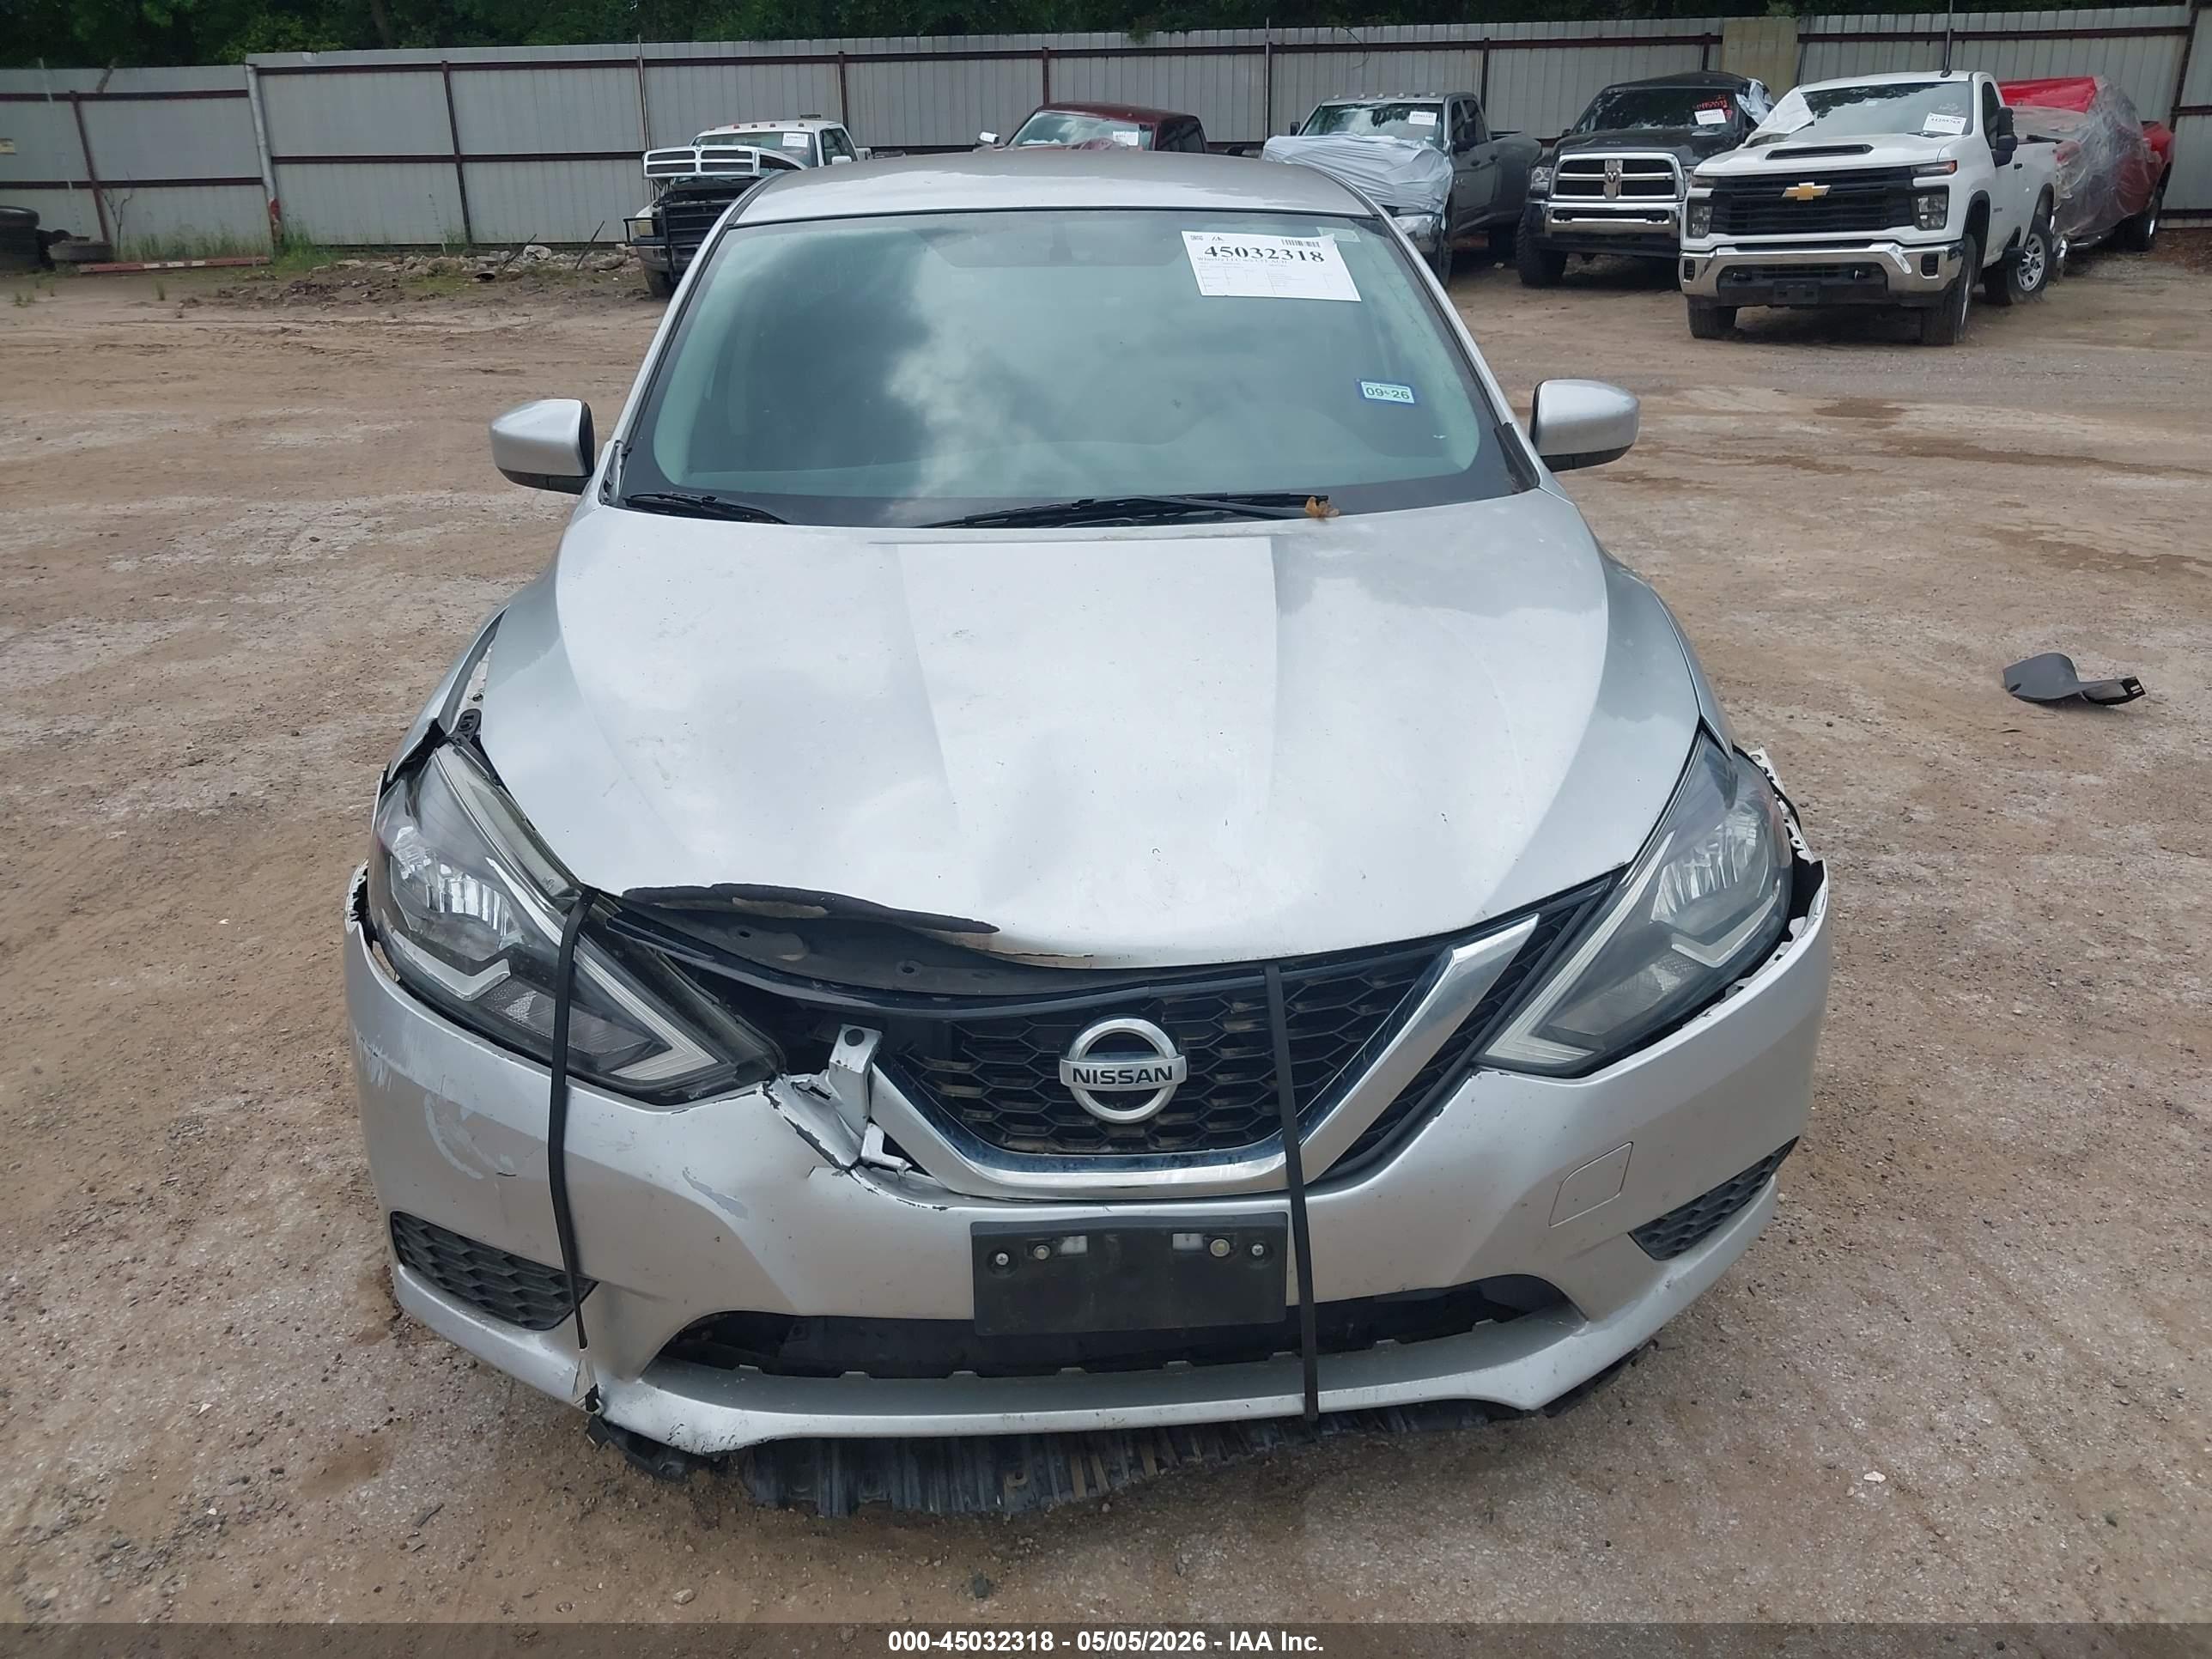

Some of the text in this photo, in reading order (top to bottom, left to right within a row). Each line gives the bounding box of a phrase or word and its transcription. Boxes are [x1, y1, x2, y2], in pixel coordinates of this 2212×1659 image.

[1204, 246, 1325, 263] 45032318
[1365, 386, 1384, 397] 09
[1391, 390, 1410, 399] 26
[1073, 1065, 1174, 1085] NISSAN
